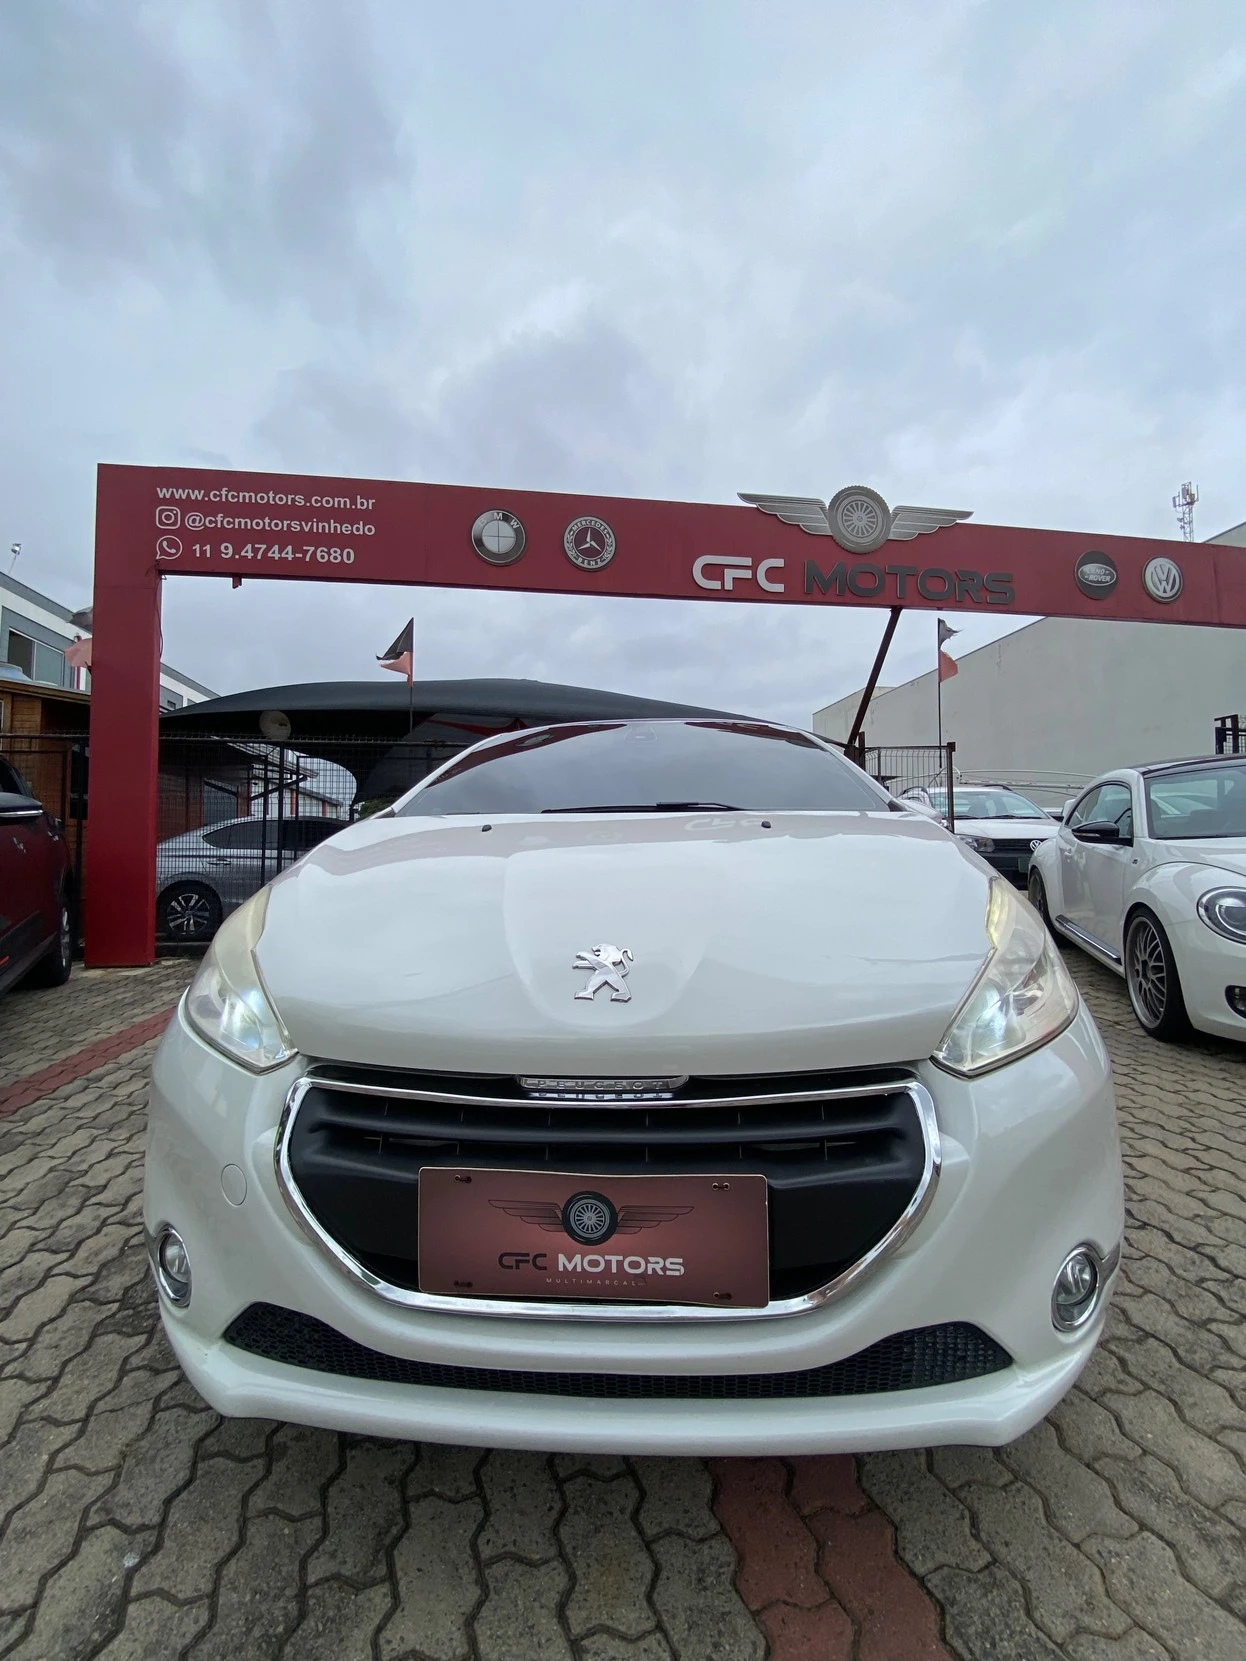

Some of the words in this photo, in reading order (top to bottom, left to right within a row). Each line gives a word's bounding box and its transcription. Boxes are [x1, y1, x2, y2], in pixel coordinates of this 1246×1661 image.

[156, 487, 376, 510] www.cfcmotors.com.br
[184, 511, 376, 536] @cfcmotorsvinhedo
[571, 519, 608, 536] MERCEDES
[192, 544, 211, 558] 11
[220, 542, 355, 564] 9.4744-7680
[692, 554, 785, 593] CFC
[804, 559, 1016, 605] MOTORS
[537, 1080, 665, 1090] PEUGEOT
[498, 1252, 547, 1271] CFC
[558, 1253, 685, 1277] MOTORS
